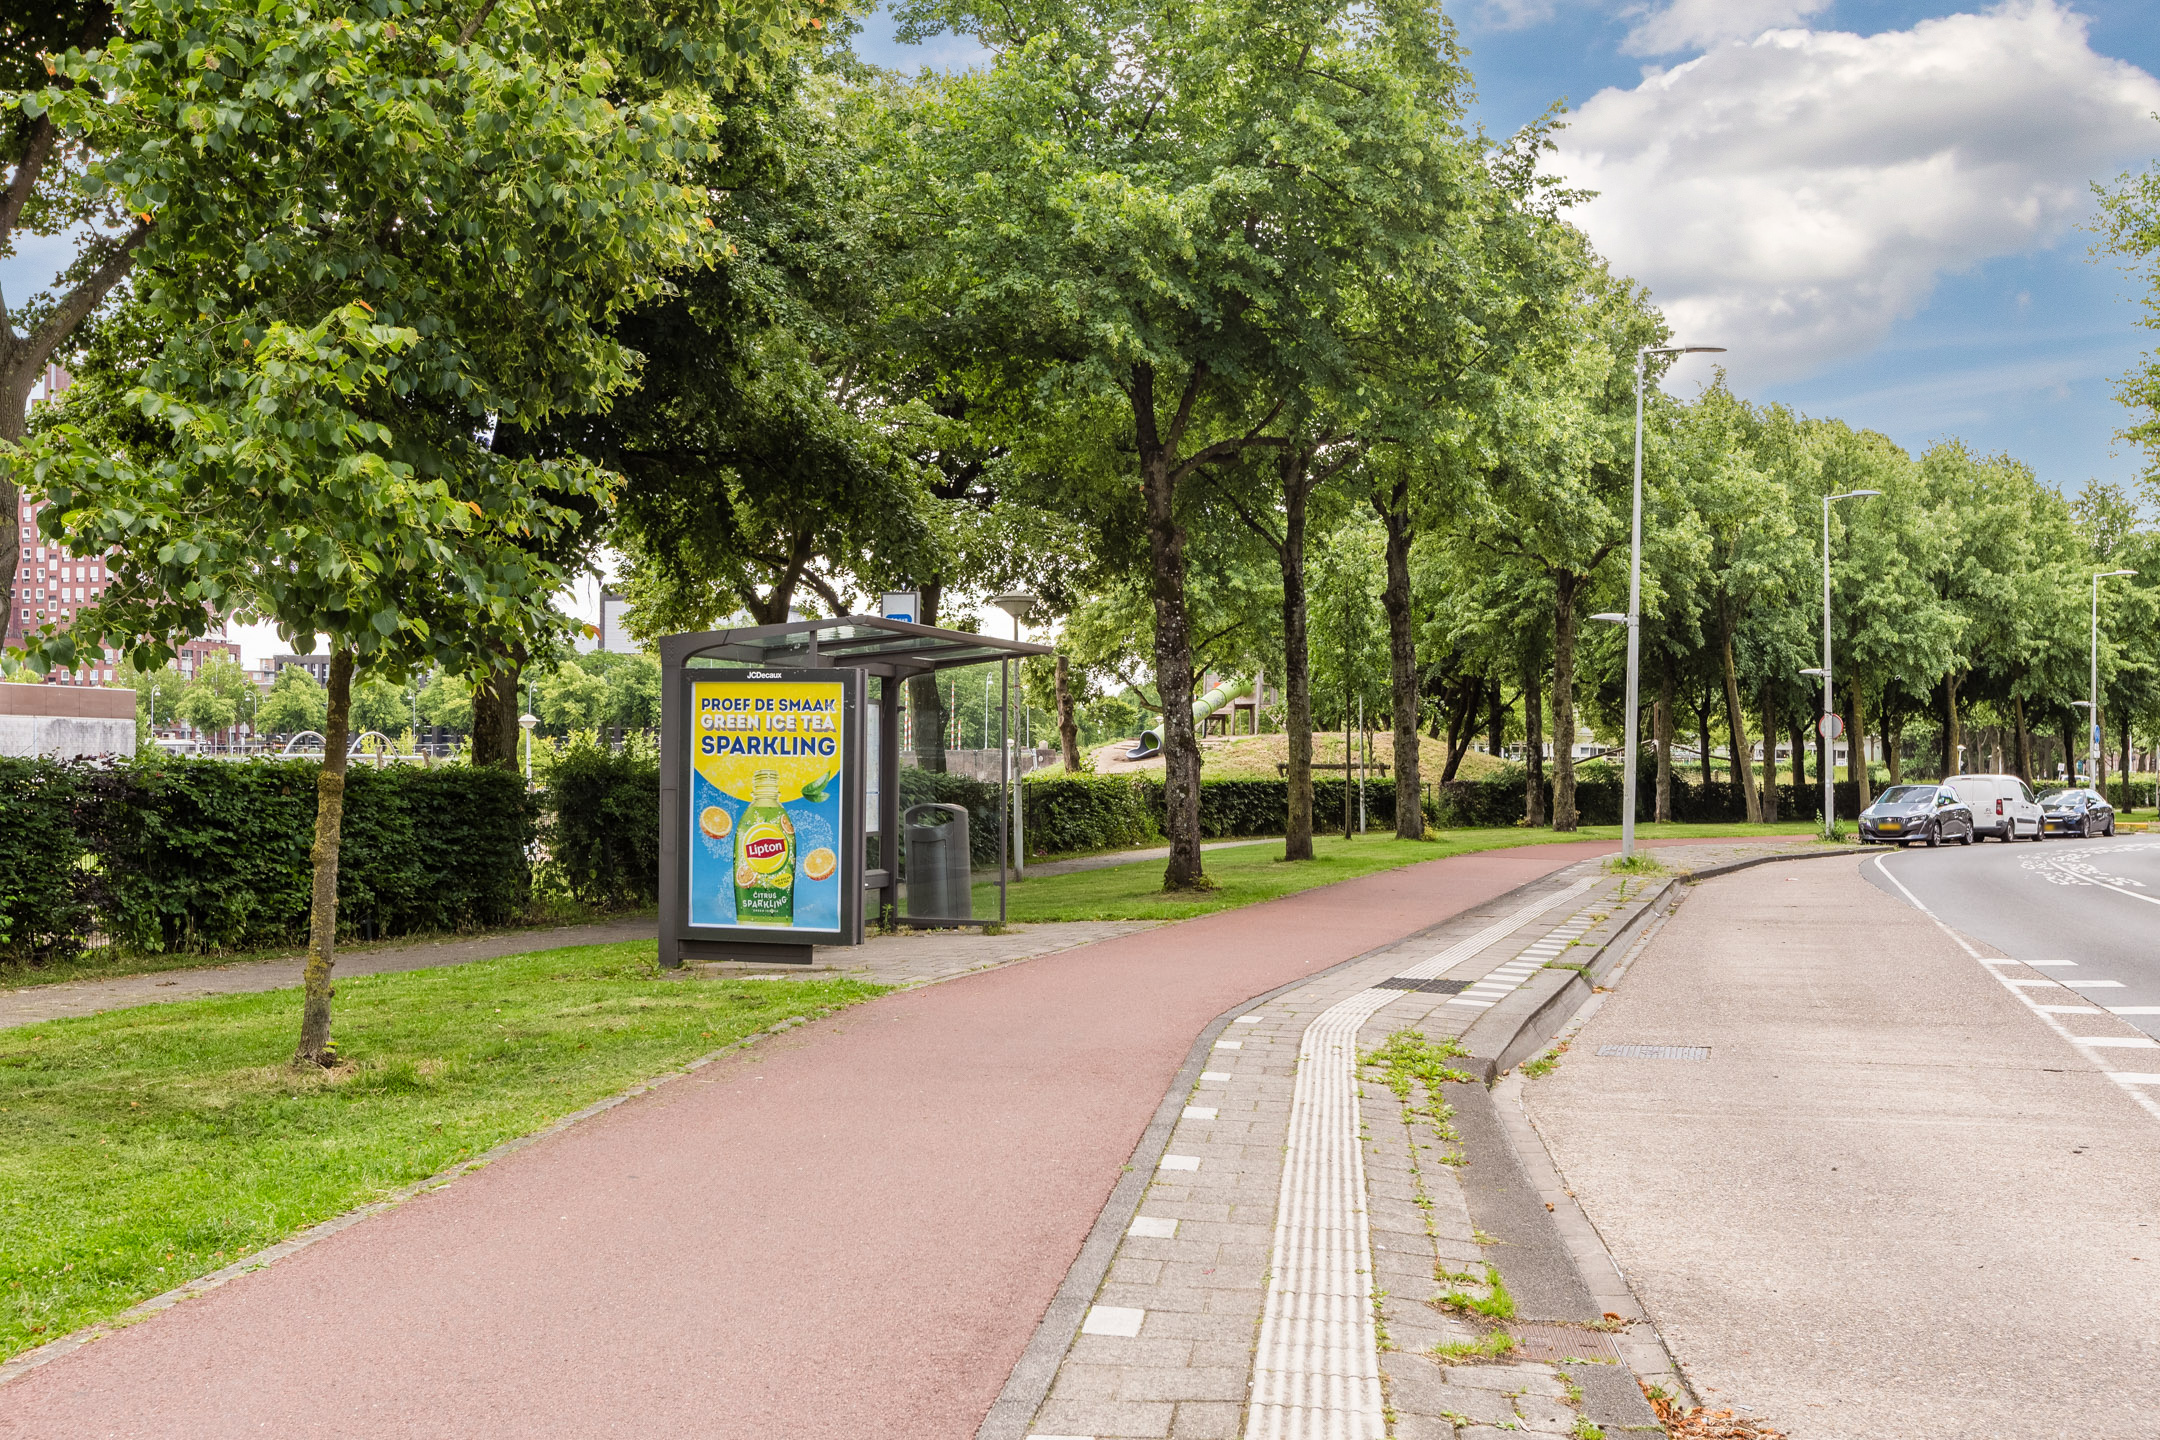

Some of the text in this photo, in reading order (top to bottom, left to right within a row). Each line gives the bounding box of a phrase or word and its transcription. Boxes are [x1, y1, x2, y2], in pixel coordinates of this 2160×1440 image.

[747, 671, 782, 679] JCDecaux
[701, 698, 836, 712] PROEF DE SMAAK
[700, 714, 836, 732] GREEN ICE TEA
[701, 735, 836, 757] SPARKLING
[749, 843, 782, 856] Lipton
[753, 891, 777, 899] CITRUS
[742, 896, 787, 909] SPARKLING
